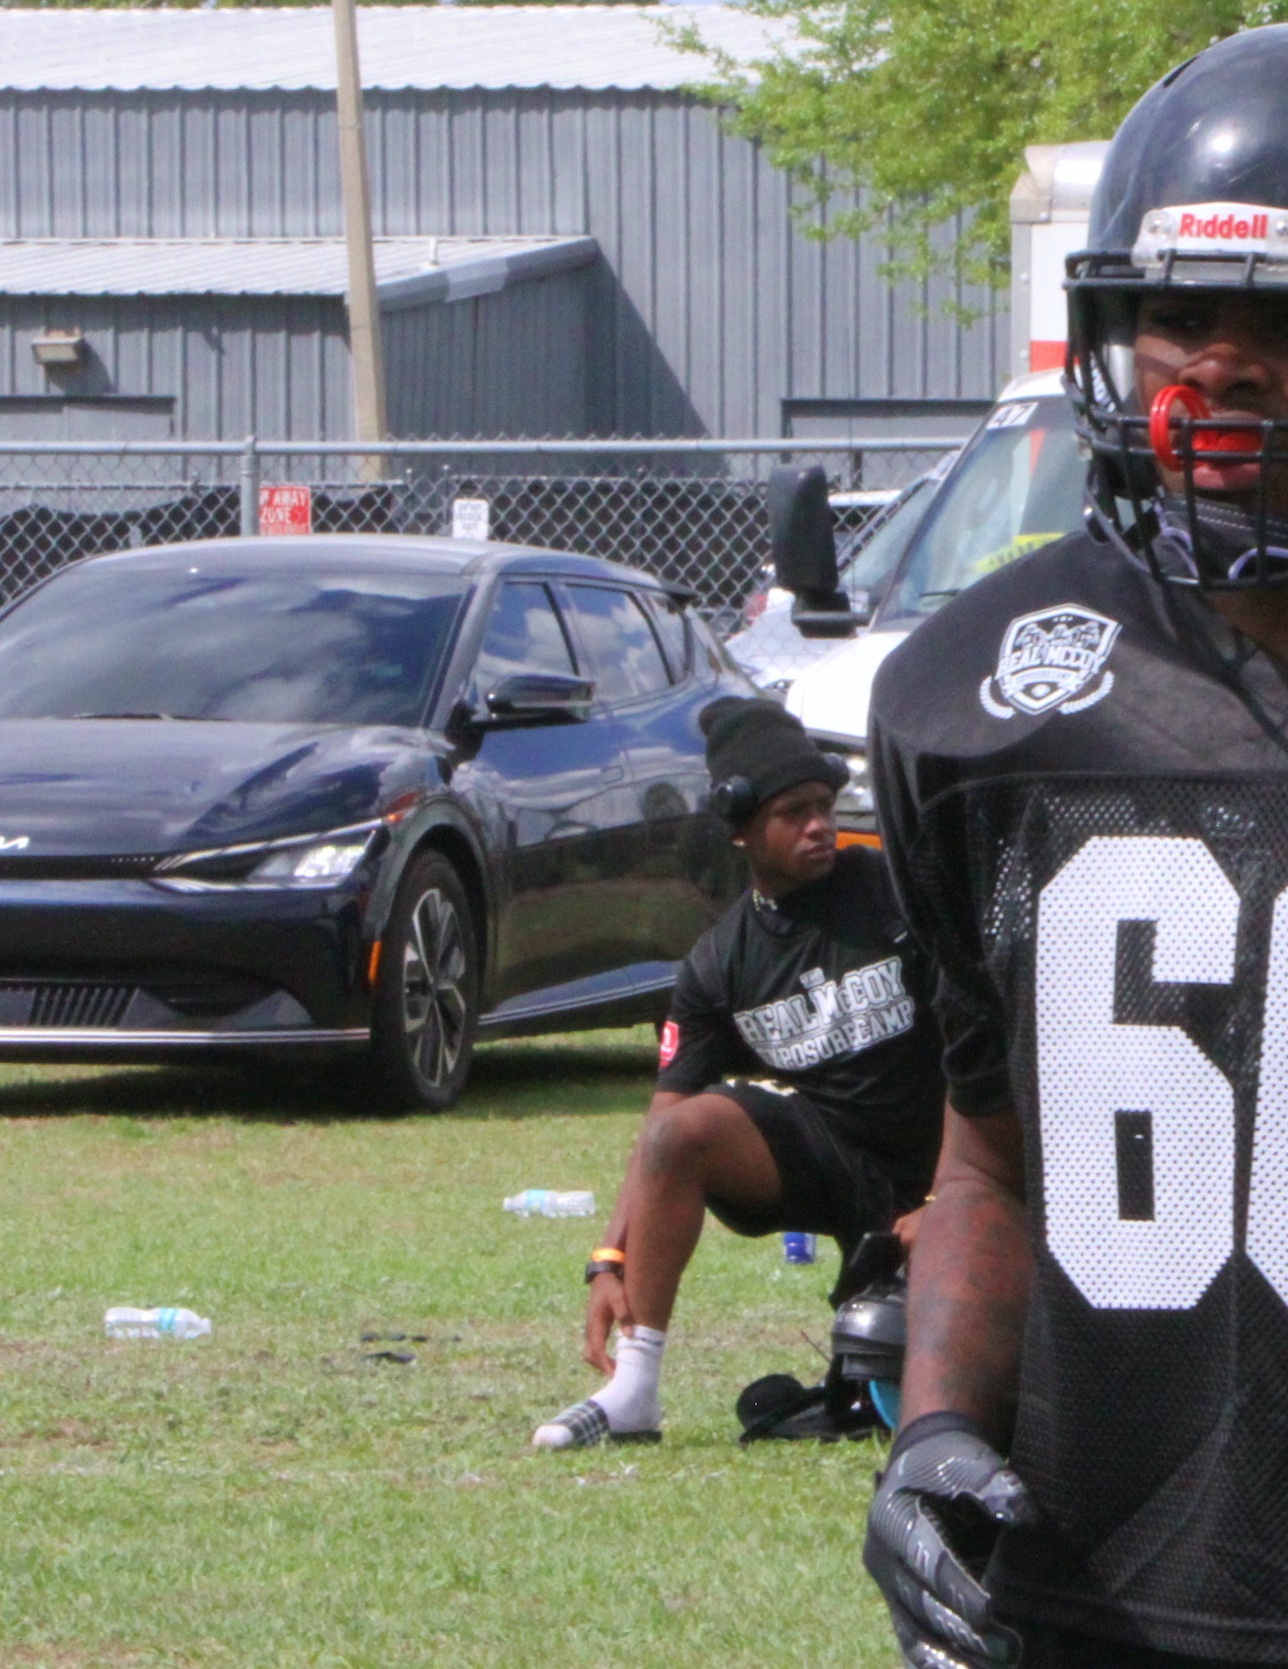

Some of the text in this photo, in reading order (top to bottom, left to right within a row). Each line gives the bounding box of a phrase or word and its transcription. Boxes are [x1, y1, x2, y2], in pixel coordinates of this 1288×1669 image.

[1179, 213, 1268, 239] Riddell
[734, 994, 820, 1042] REAL
[852, 997, 915, 1046] CAMP
